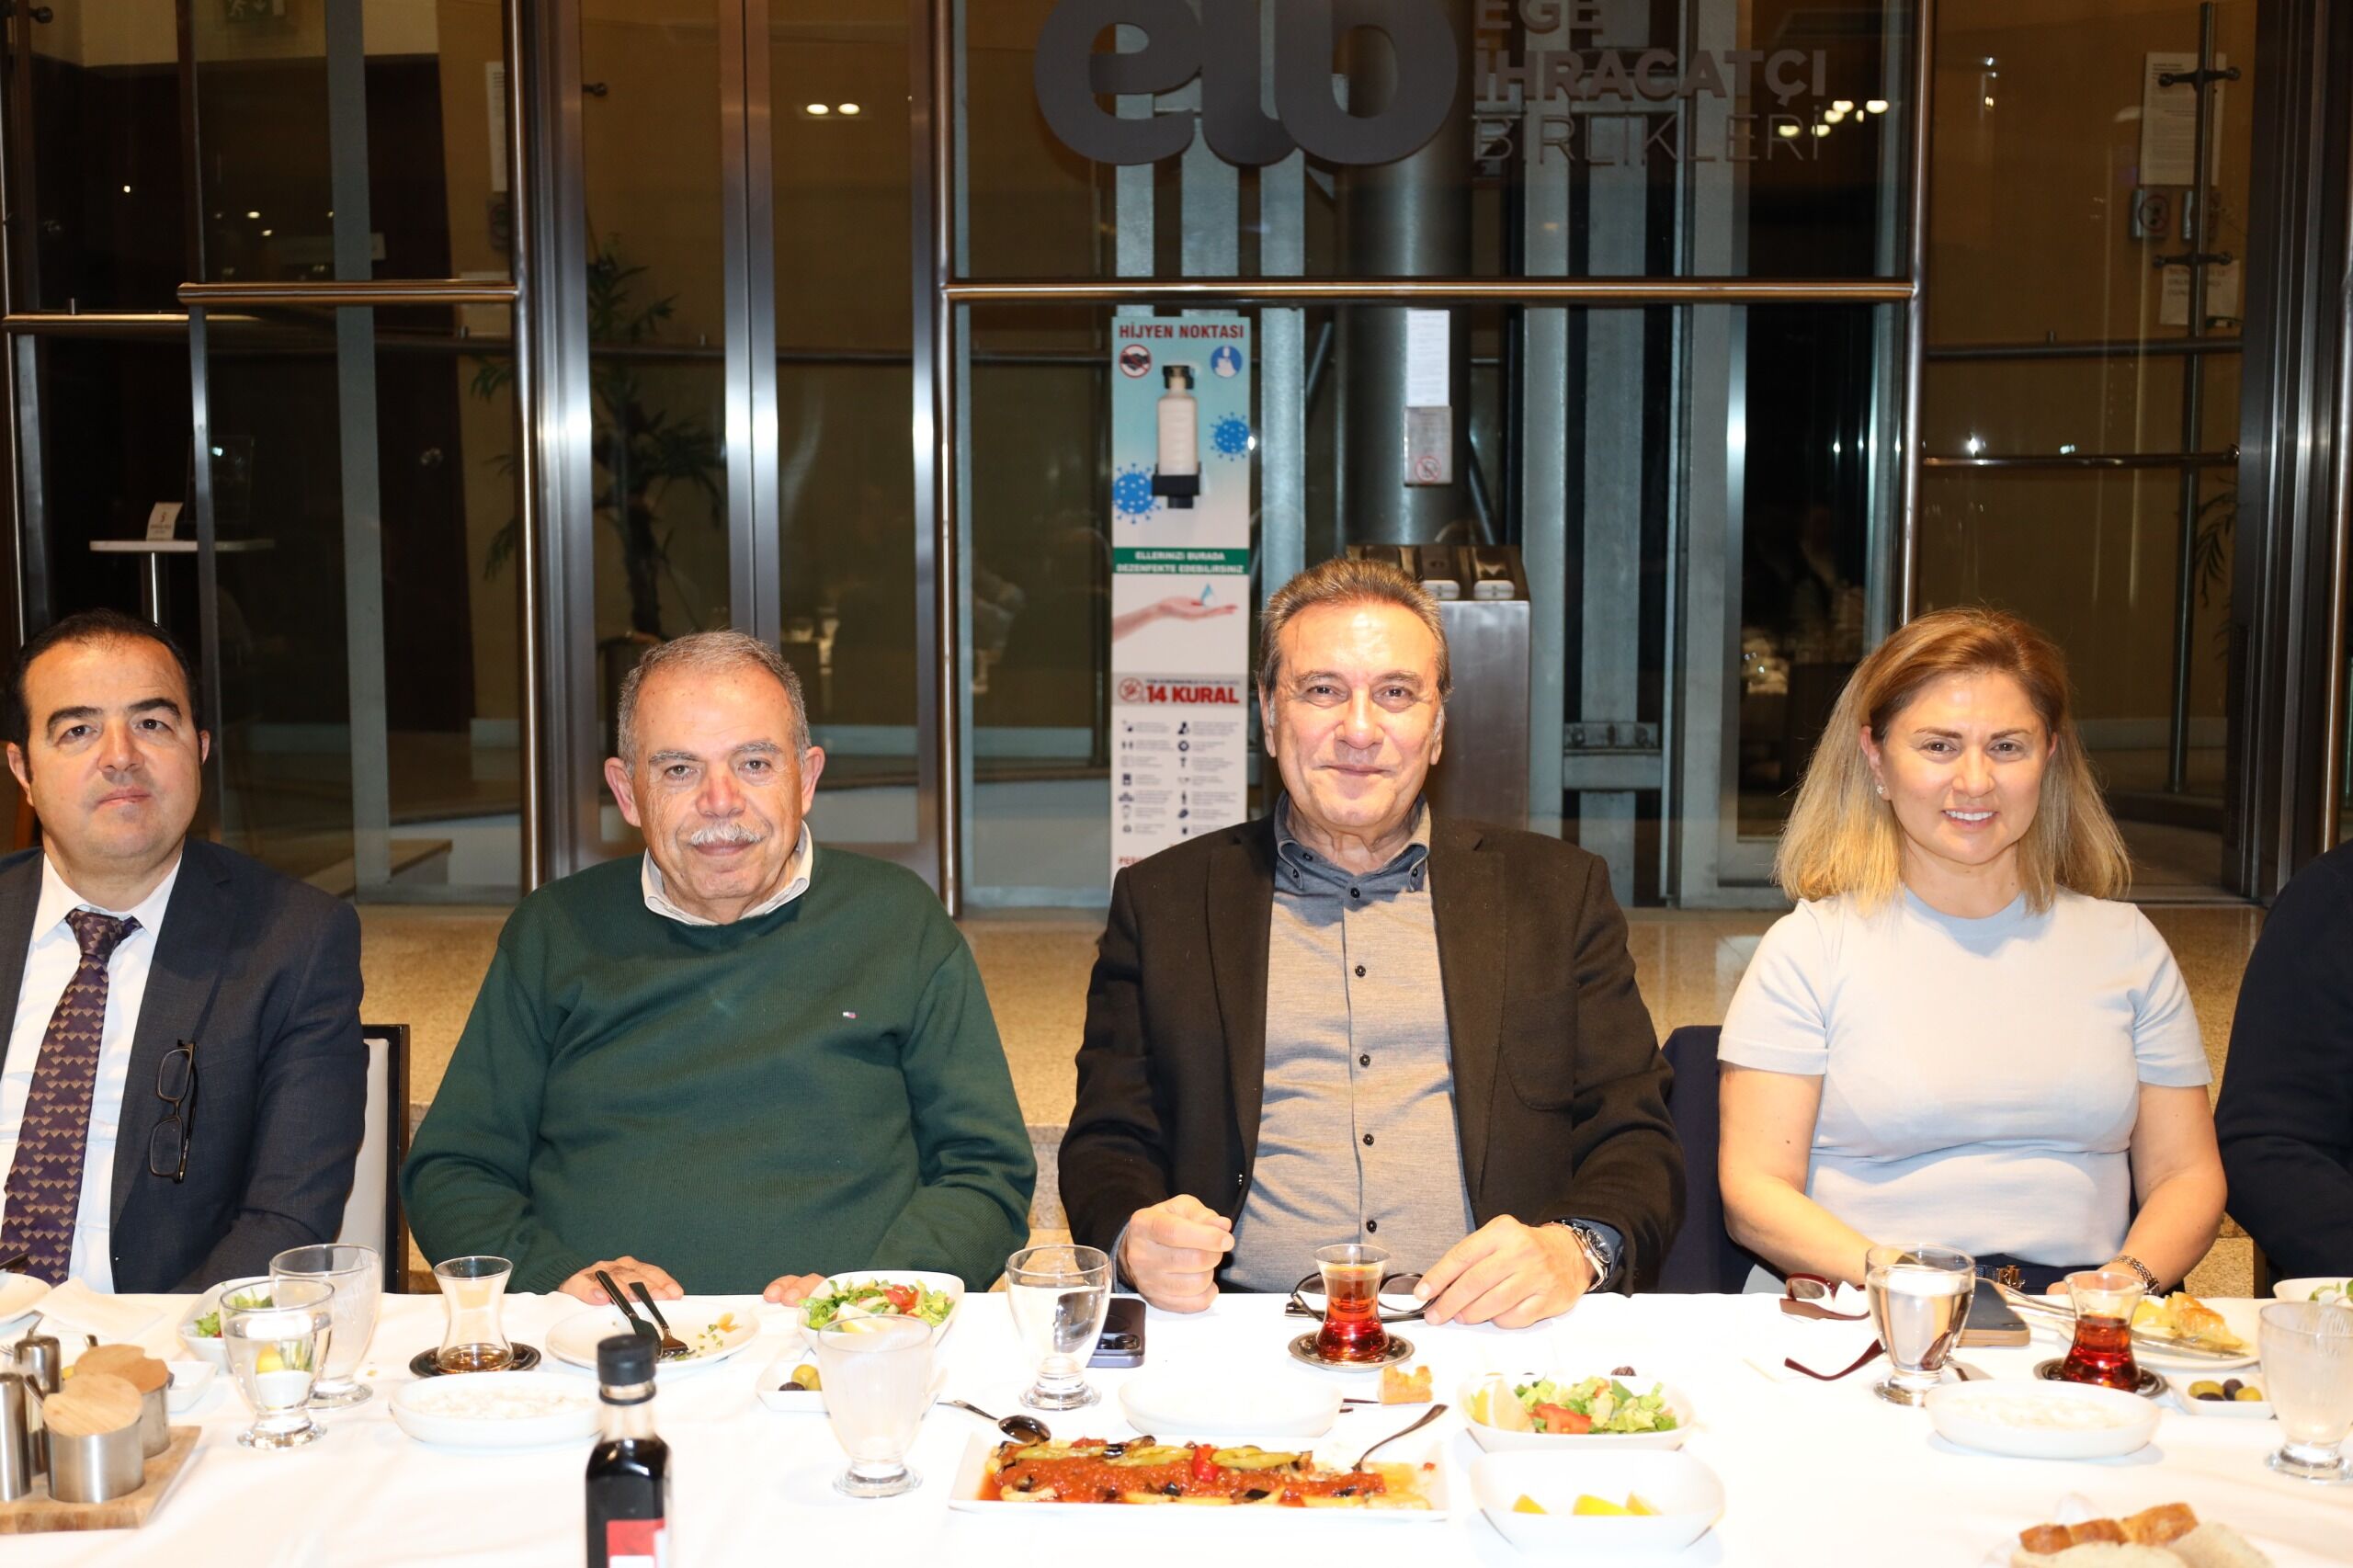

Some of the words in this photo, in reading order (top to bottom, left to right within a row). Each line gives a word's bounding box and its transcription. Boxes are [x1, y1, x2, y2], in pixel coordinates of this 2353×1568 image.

[1474, 0, 1603, 35] EGE
[1120, 322, 1174, 339] HİJYEN
[1179, 324, 1245, 339] NOKTASI
[1146, 684, 1167, 703] 14
[1172, 685, 1240, 704] KURAL
